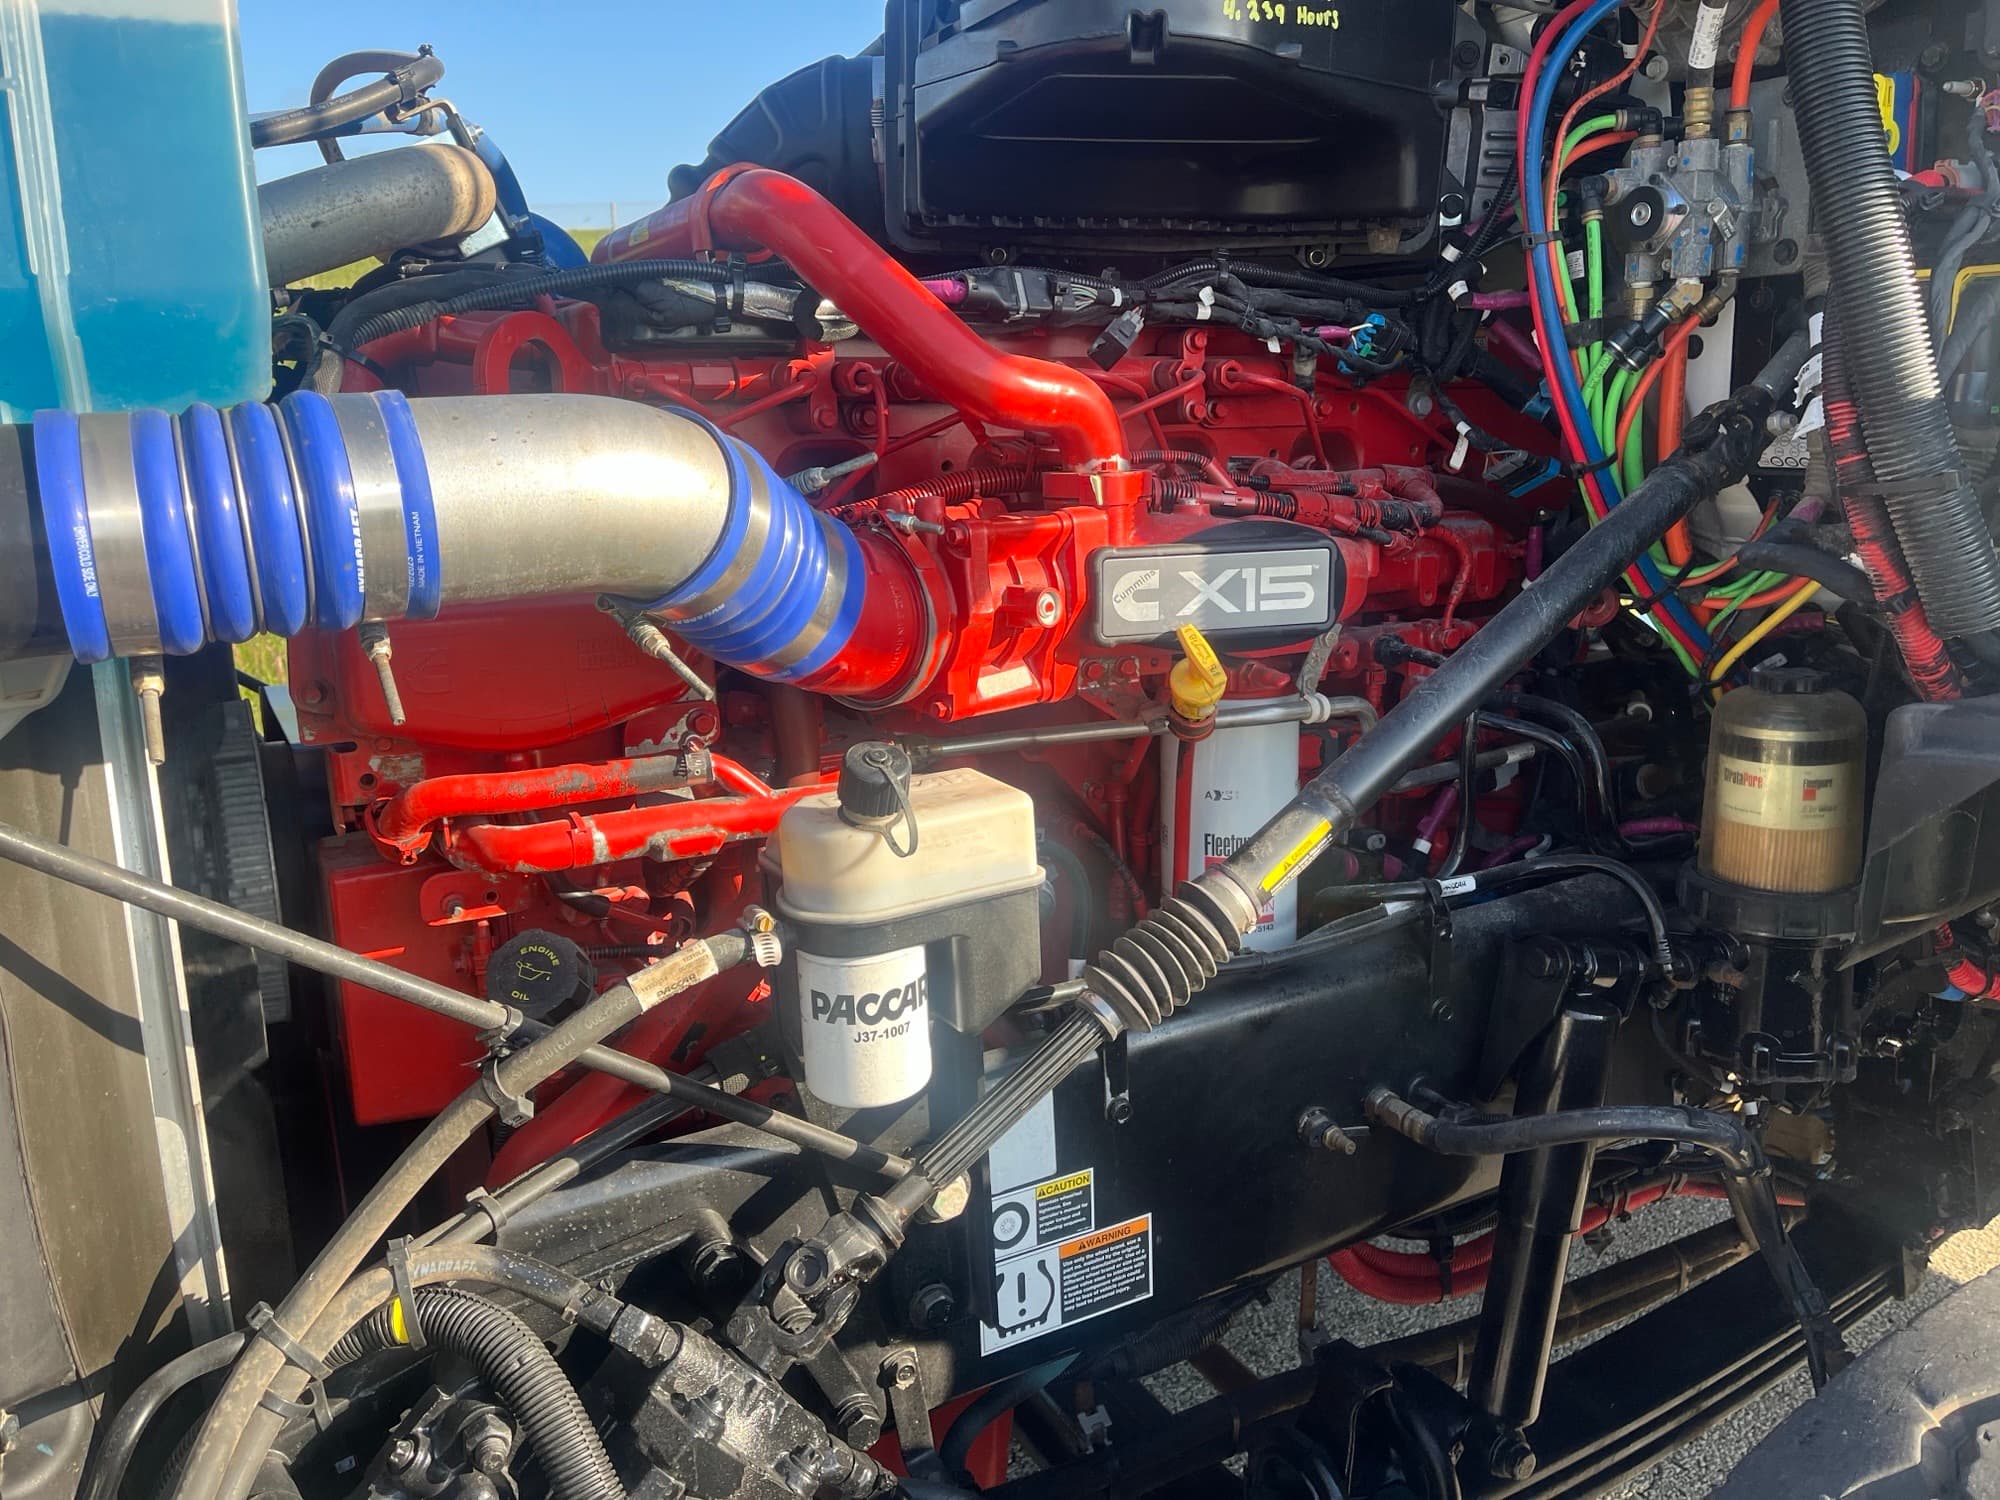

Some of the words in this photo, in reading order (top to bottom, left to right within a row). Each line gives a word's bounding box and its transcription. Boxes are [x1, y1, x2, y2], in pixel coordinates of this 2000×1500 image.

[1297, 5, 1339, 29] Hours
[412, 511, 423, 553] VIETNAM
[416, 555, 424, 564] IN
[1113, 569, 1156, 604] Cummins
[1176, 564, 1316, 617] X15
[520, 945, 560, 967] ENGINE
[511, 990, 530, 1001] OIL
[656, 973, 697, 998] PACCAR
[811, 973, 928, 1026] PACCAR
[854, 1020, 911, 1043] J37-1007
[1046, 1174, 1090, 1195] CAUTION
[1086, 1226, 1131, 1248] WARNING
